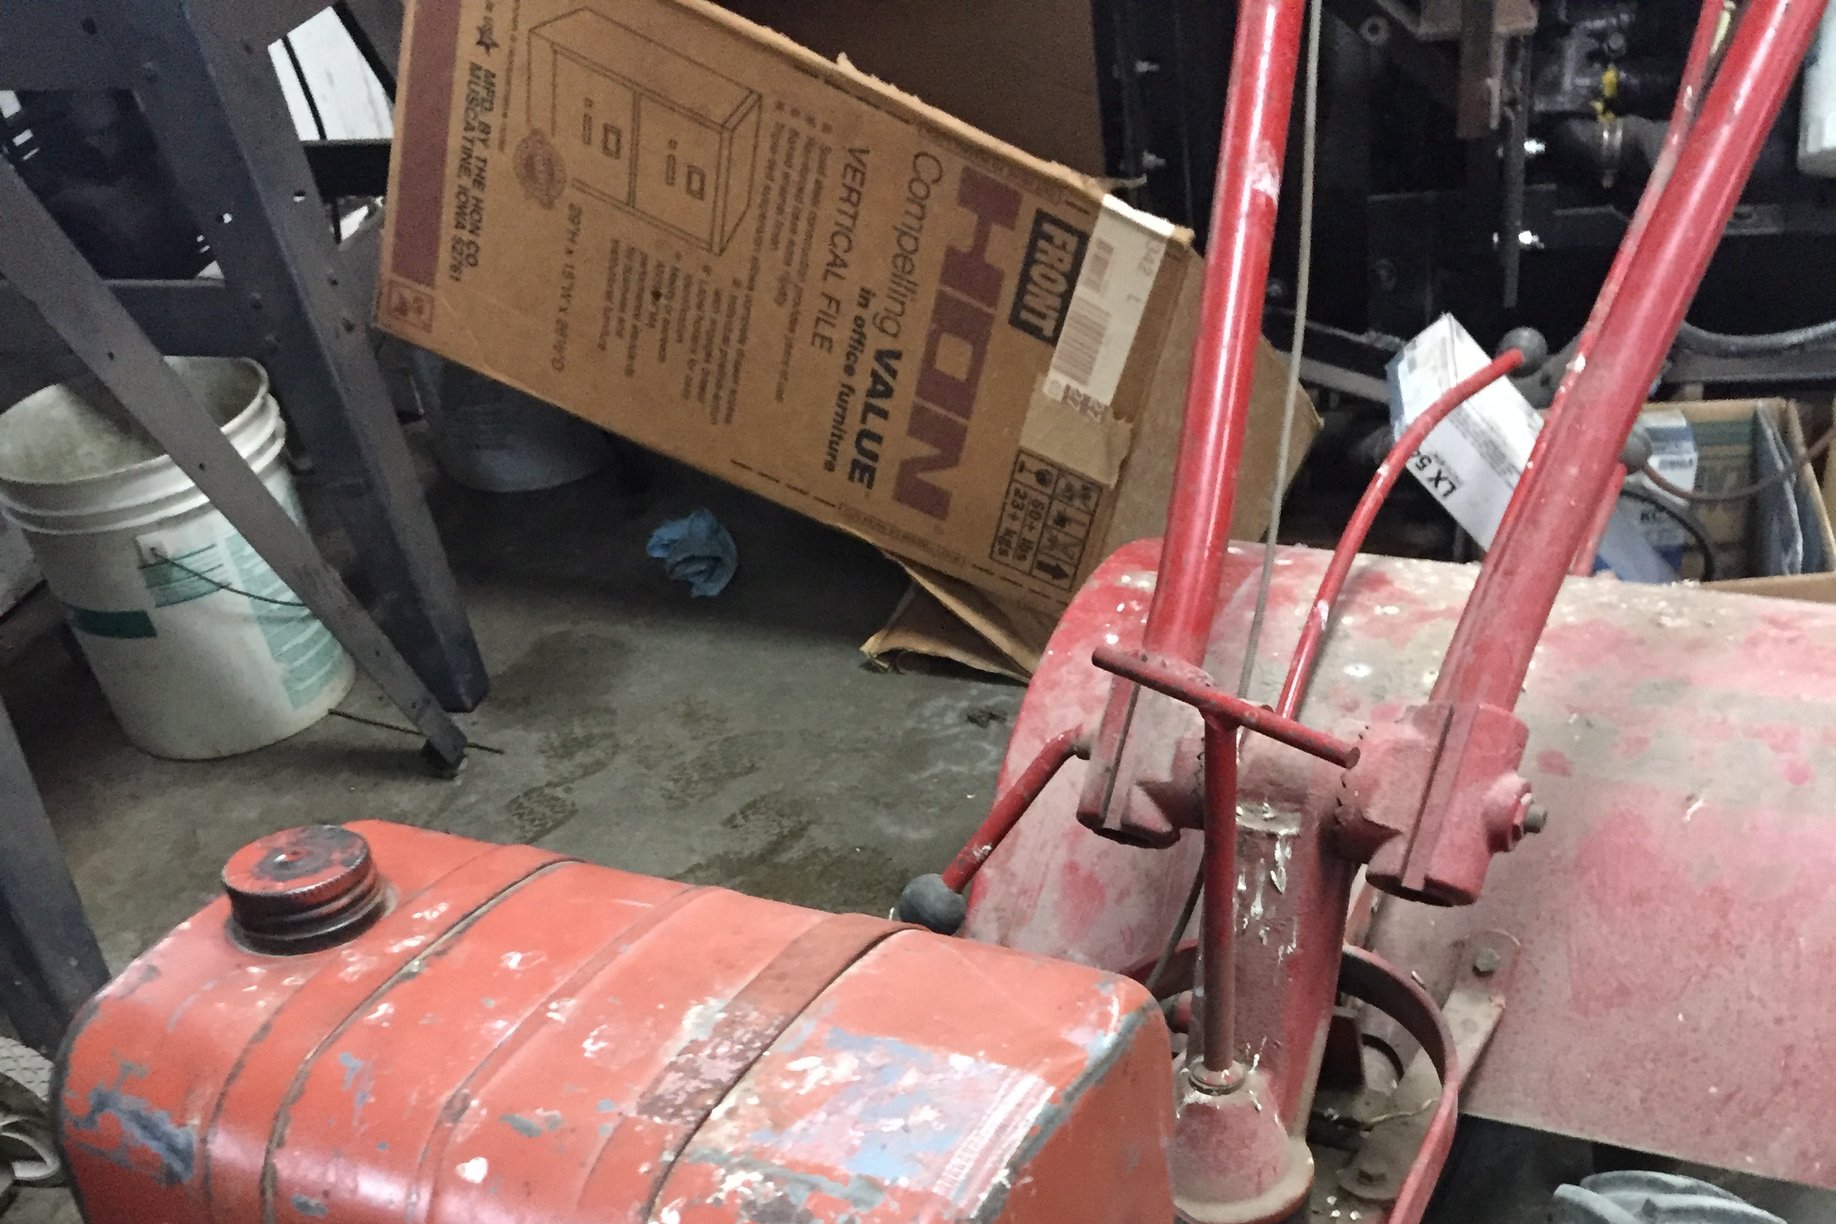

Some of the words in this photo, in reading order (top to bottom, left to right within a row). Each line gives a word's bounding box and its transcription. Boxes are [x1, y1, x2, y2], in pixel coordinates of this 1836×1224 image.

[477, 121, 491, 147] BY
[473, 157, 487, 191] THE
[455, 185, 469, 229] IOWA
[468, 196, 483, 235] HON
[823, 148, 870, 281] VERTICAL
[872, 151, 944, 339] Compelling
[857, 287, 875, 309] in
[1021, 222, 1076, 338] FRONT
[811, 292, 841, 353] FILE
[844, 315, 866, 377] office
[894, 166, 1021, 520] HON
[824, 383, 855, 472] furniture
[848, 350, 902, 489] VALUE
[1428, 470, 1456, 497] LX
[997, 524, 1017, 558] kgs
